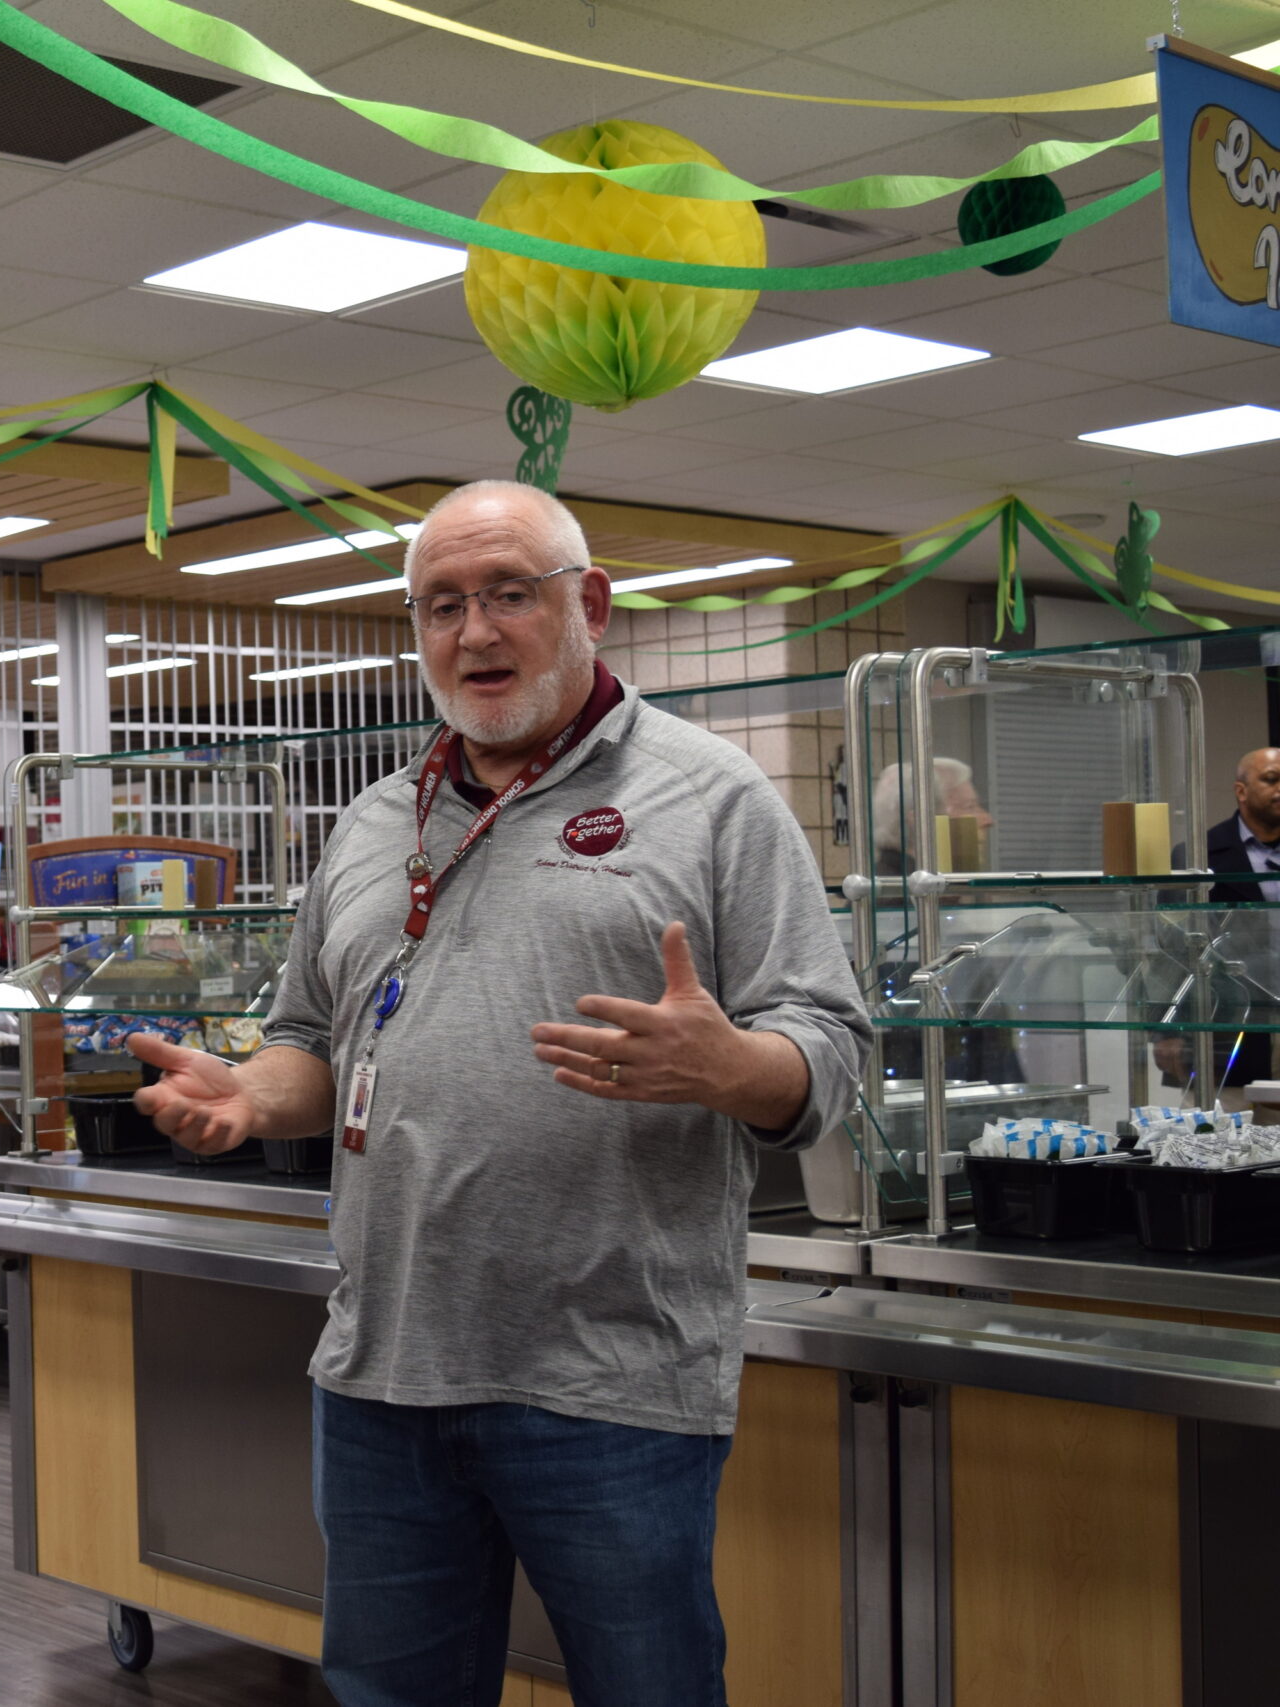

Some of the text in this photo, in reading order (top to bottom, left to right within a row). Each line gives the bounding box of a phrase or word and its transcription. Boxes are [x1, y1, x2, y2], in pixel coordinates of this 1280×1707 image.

[420, 771, 437, 808] HOLMEN
[495, 779, 525, 809] SCHOOL
[468, 805, 498, 838] DISTRICT
[576, 813, 620, 828] Better
[52, 869, 88, 896] Fun
